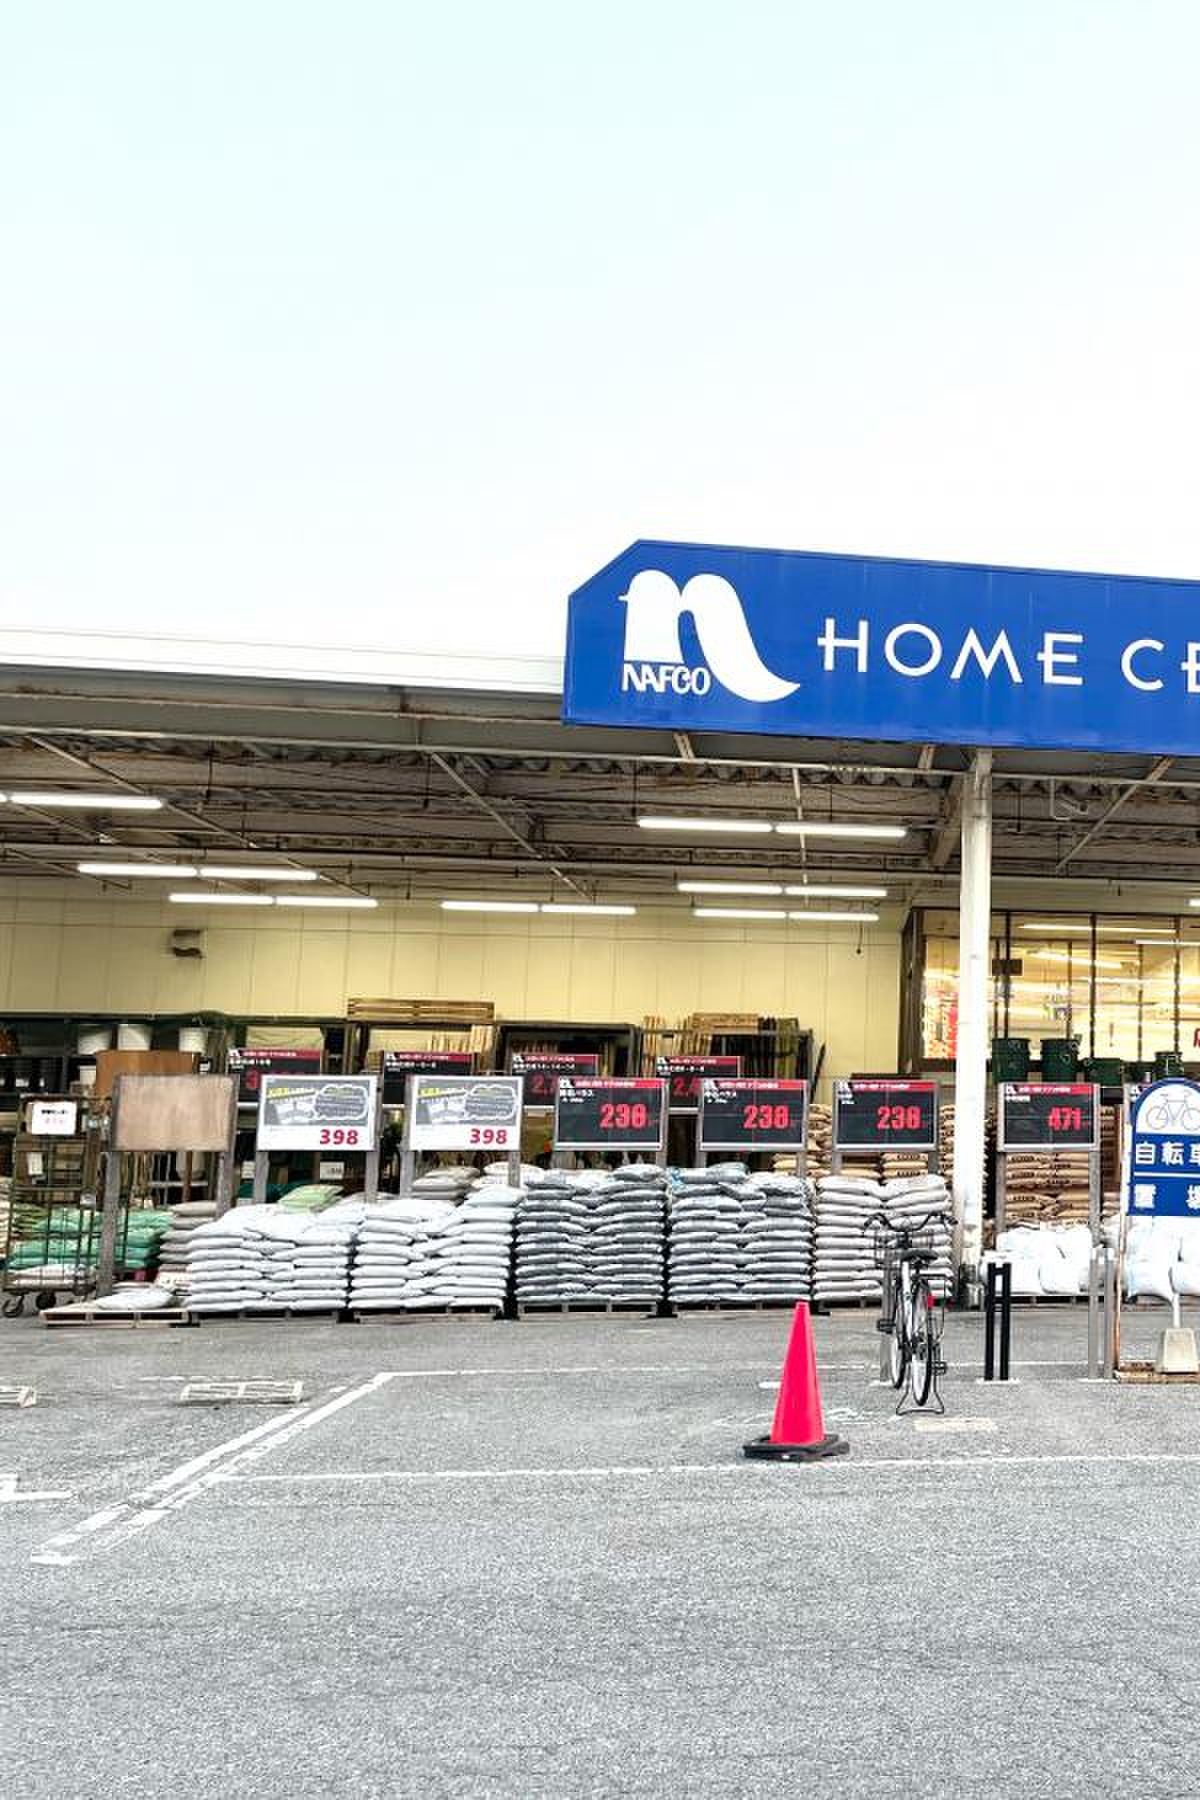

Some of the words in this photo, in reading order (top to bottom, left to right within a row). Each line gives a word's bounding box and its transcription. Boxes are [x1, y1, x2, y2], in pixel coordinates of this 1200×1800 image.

[817, 617, 1083, 686] HOME
[621, 663, 711, 695] NAFCO
[319, 1128, 360, 1146] 398
[469, 1128, 508, 1145] 398
